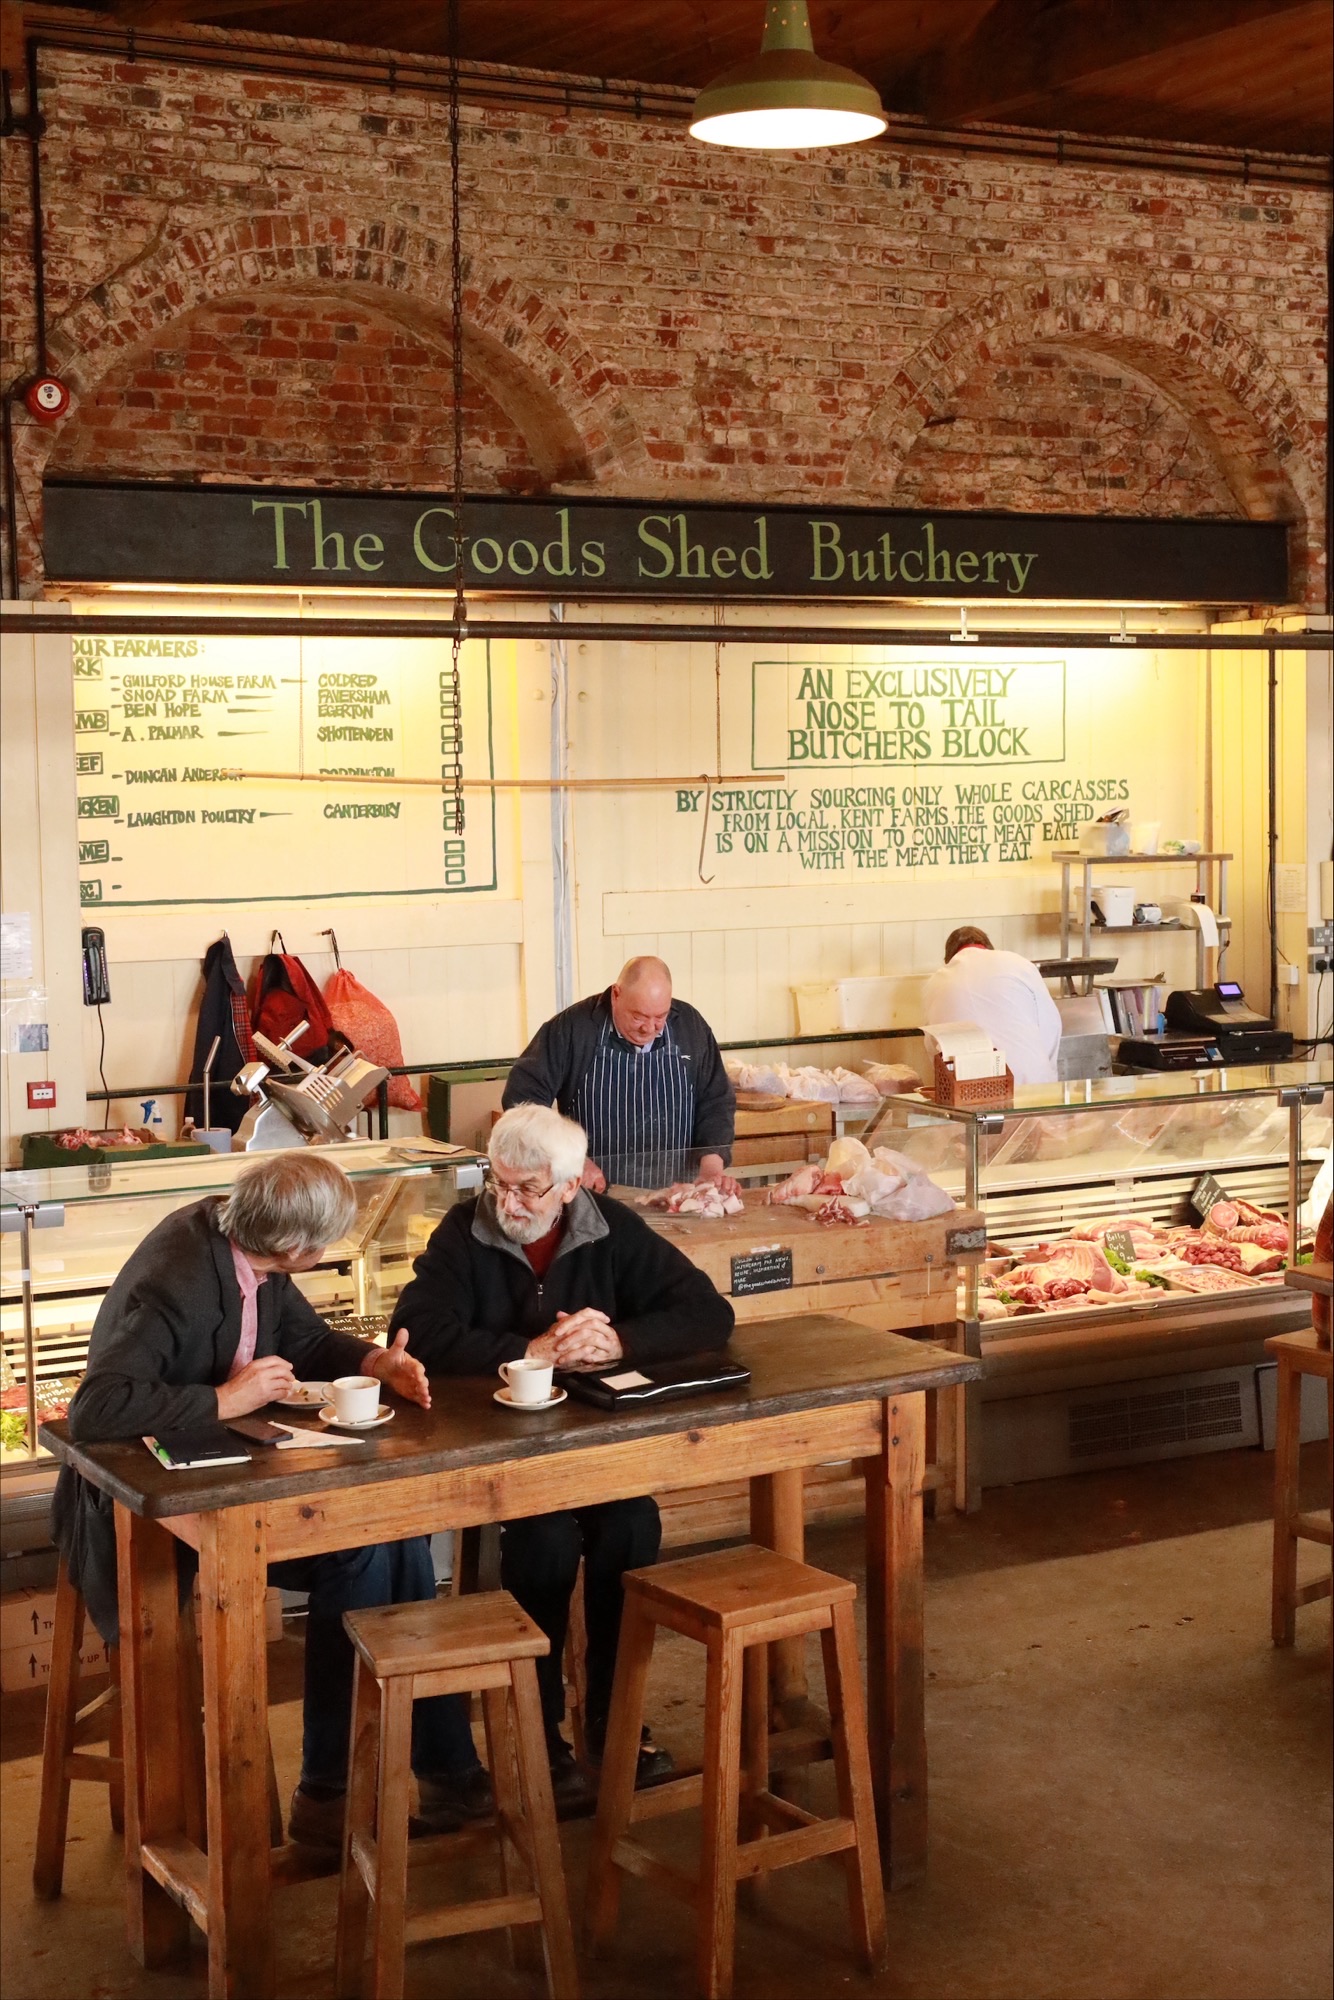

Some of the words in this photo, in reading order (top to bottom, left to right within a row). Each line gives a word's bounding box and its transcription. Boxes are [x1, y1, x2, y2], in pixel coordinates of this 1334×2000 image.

[252, 499, 384, 571] The
[413, 507, 606, 577] Goods
[637, 513, 774, 580] Shed
[809, 521, 1039, 594] Butchery
[112, 638, 206, 658] FARMERS:
[122, 674, 186, 688] GUILFORD
[190, 674, 234, 688] HOUSE
[237, 675, 277, 689] FARM
[318, 673, 378, 688] COLDRED
[796, 667, 834, 700] AN
[846, 667, 1018, 699] EXCLUSIVELY
[122, 689, 177, 702] SNOAD
[182, 689, 228, 703] FARM
[318, 689, 391, 704] FAVERSHAM
[123, 702, 157, 718] BEN
[163, 702, 202, 718] HOPE
[318, 704, 373, 719] EGERTON
[806, 700, 876, 730] NOSE
[889, 701, 925, 729] TO
[941, 699, 1005, 727] TAIL
[147, 725, 204, 740] PALMAR
[317, 725, 394, 742] SHOTTENDEN
[787, 729, 932, 760] BUTCHERS
[941, 727, 1031, 758] BLOCK
[125, 767, 178, 785] DUNCAN
[676, 790, 704, 812] BY
[712, 789, 798, 811] STRICTLY
[810, 787, 895, 809] SOURCING
[902, 786, 943, 806] ONLY
[955, 783, 1012, 805] WHOLE
[1022, 779, 1129, 801] CARCASSES
[127, 810, 196, 828] LAUGHTON
[201, 808, 257, 824] POULTRY
[323, 801, 401, 819] CANTERBURY
[723, 812, 770, 832] FROM
[840, 808, 883, 829] KENT
[955, 805, 984, 825] THE
[993, 804, 1043, 824] GOODS
[1054, 803, 1094, 823] SHED
[715, 833, 733, 853] IS
[744, 832, 768, 853] ON
[776, 831, 793, 852] A
[797, 829, 872, 852] MISSION
[883, 828, 904, 848] TO
[912, 825, 987, 846] CONNECT
[994, 823, 1035, 843] MEAT
[800, 852, 844, 870] WITH
[853, 849, 888, 868] THE
[896, 846, 942, 867] MEAT
[946, 844, 991, 865] THEY
[999, 842, 1032, 862] EAT.
